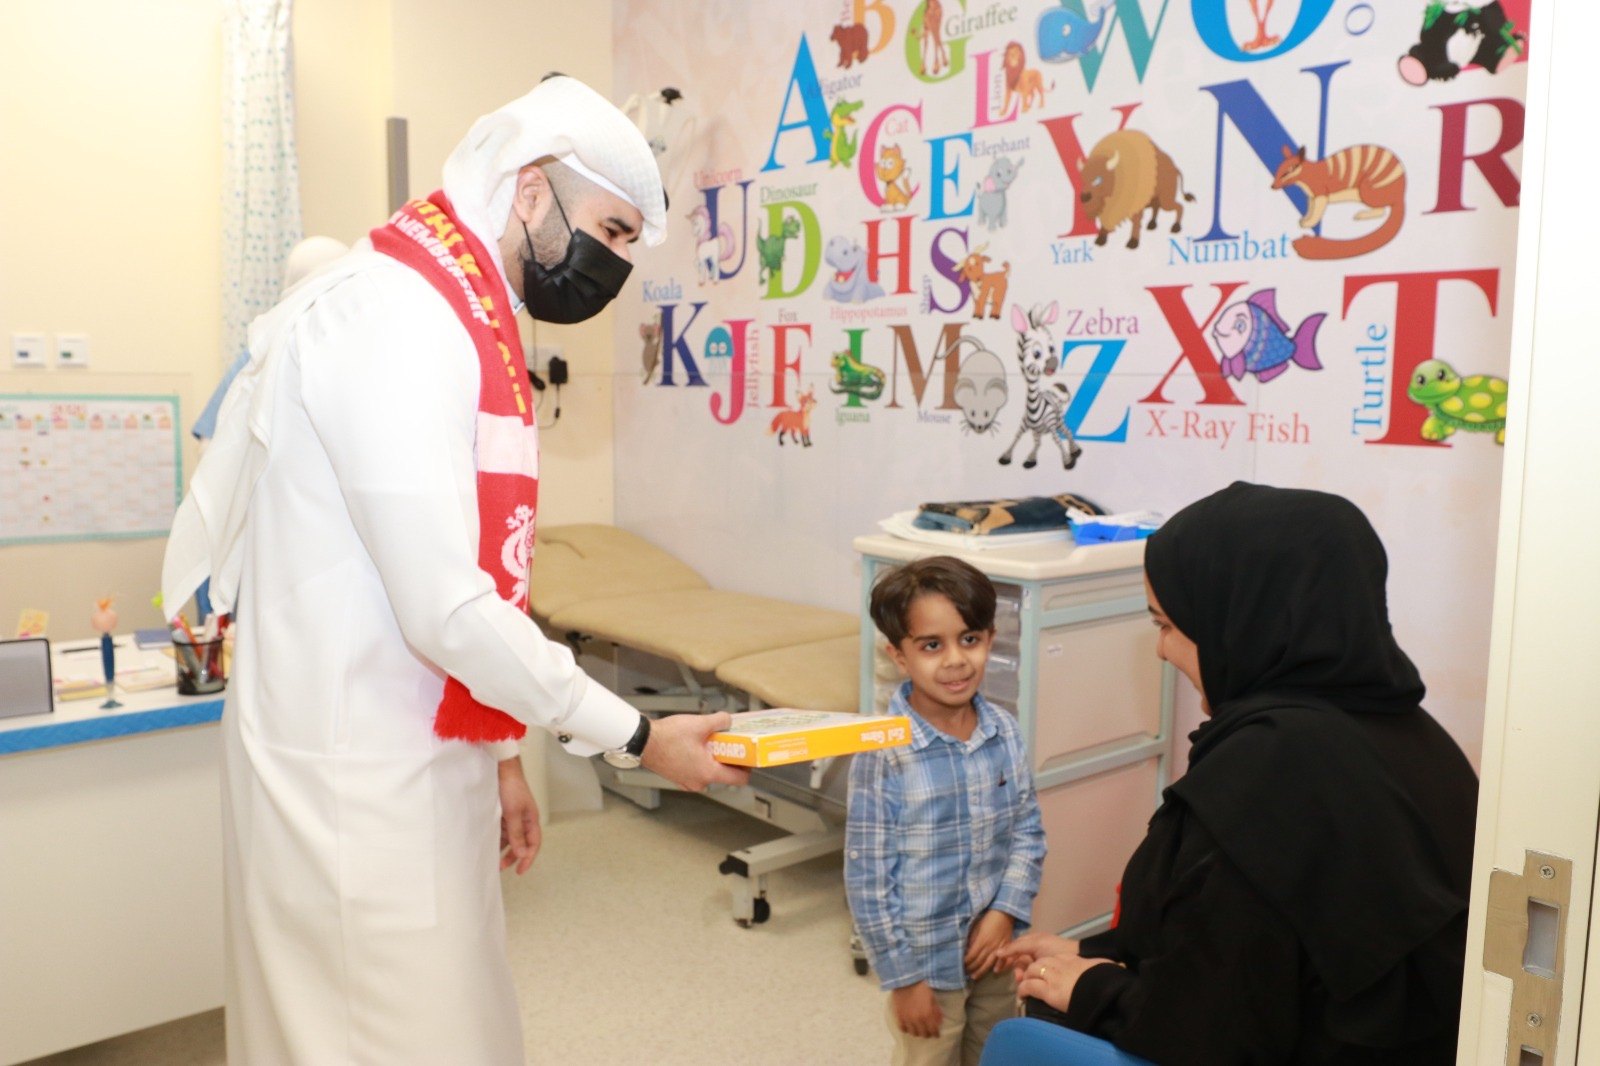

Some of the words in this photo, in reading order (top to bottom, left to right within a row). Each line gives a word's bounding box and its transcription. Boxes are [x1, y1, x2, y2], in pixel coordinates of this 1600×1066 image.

[905, 0, 972, 83] G
[1076, 0, 1170, 94] W
[759, 32, 833, 172] A
[884, 116, 910, 137] Cat
[970, 49, 1020, 129] L
[692, 168, 743, 190] Unicorn
[858, 98, 924, 209] C
[921, 131, 977, 222] E
[973, 136, 1031, 159] Elephant
[1038, 102, 1143, 239] Y
[1199, 60, 1351, 240] N
[1421, 97, 1526, 215] R
[700, 179, 755, 280] U
[760, 183, 819, 203] Dinosaur
[642, 277, 683, 302] Koala
[760, 200, 822, 299] D
[861, 214, 919, 295] H
[930, 226, 973, 314] S
[1050, 240, 1095, 265] Yark
[1167, 235, 1290, 267] Numbat
[656, 301, 710, 387] K
[778, 308, 798, 322] Fox
[830, 306, 908, 324] Hippopotamus
[1066, 308, 1140, 336] Zebra
[1138, 280, 1250, 406] X
[709, 317, 756, 426] J
[746, 328, 761, 409] Jellyfish
[766, 323, 813, 408] F
[841, 328, 871, 408] I
[884, 322, 971, 411] M
[1058, 337, 1131, 444] Z
[1341, 267, 1500, 448] T
[1352, 322, 1388, 437] Turtle
[834, 408, 870, 426] Iguana
[916, 410, 953, 425] Mouse
[1144, 409, 1236, 450] X-Ray
[1246, 412, 1311, 445] Fish
